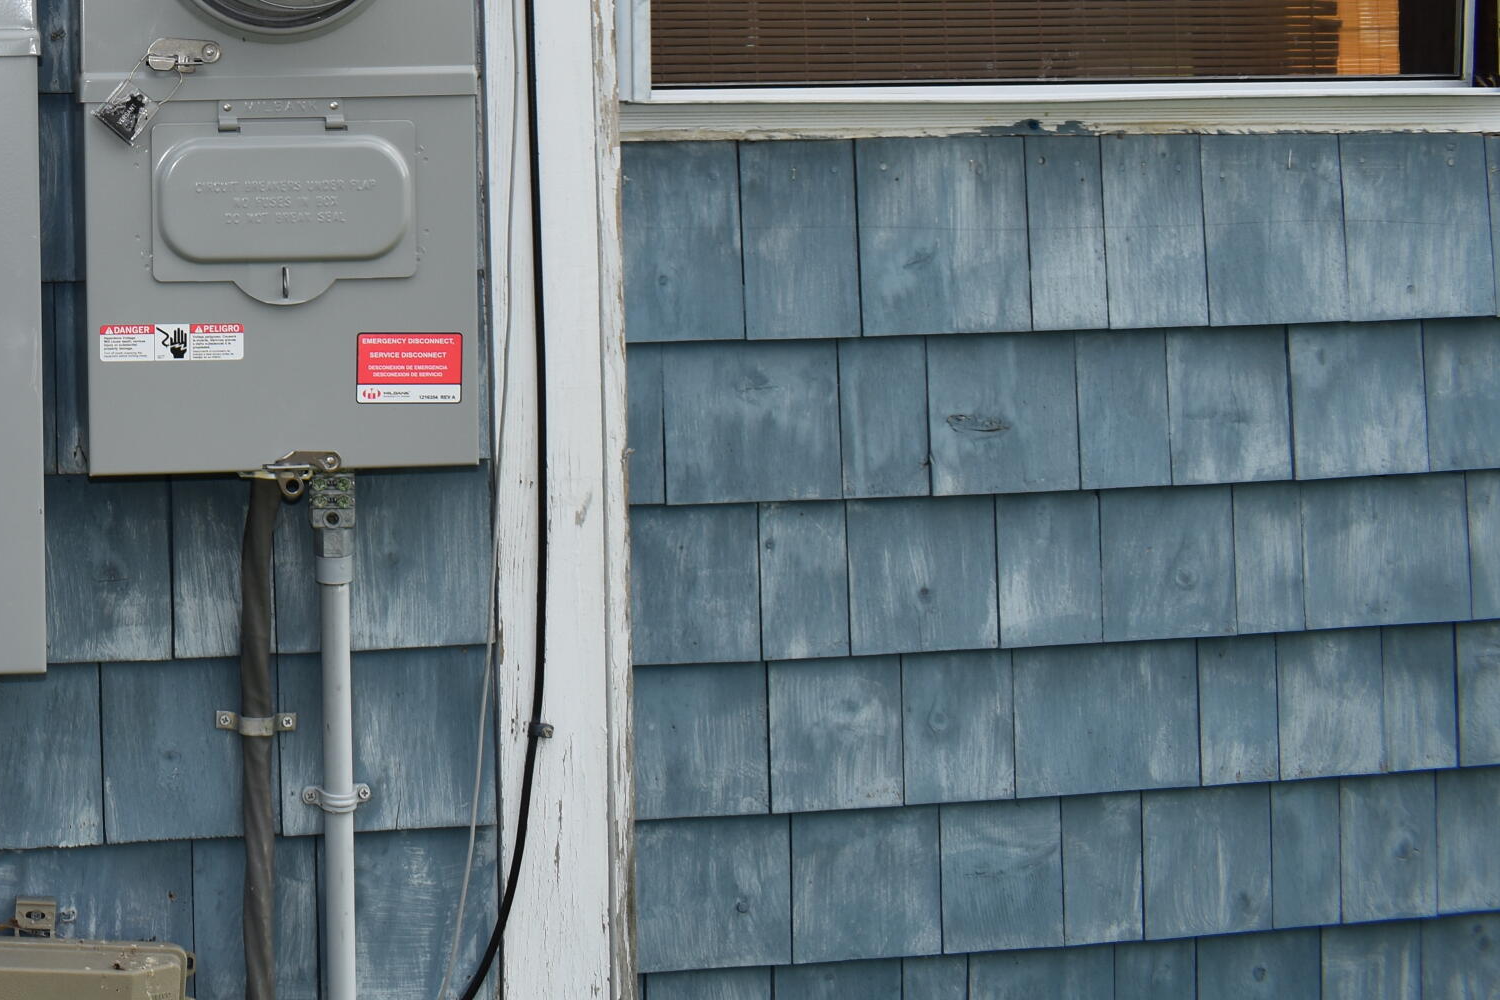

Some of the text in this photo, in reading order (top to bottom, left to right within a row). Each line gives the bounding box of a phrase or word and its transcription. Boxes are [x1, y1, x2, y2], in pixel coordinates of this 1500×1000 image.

[244, 100, 317, 112] MILBANK
[196, 178, 377, 193] CIRCUIT BREAKERS UNDER FLAP
[233, 196, 249, 208] NO
[256, 195, 291, 208] FUSES
[316, 195, 338, 207] BOX
[224, 210, 347, 224] DO NOT BREAK SEAL
[113, 326, 150, 334] DANGER
[203, 324, 240, 332] PELIGRO
